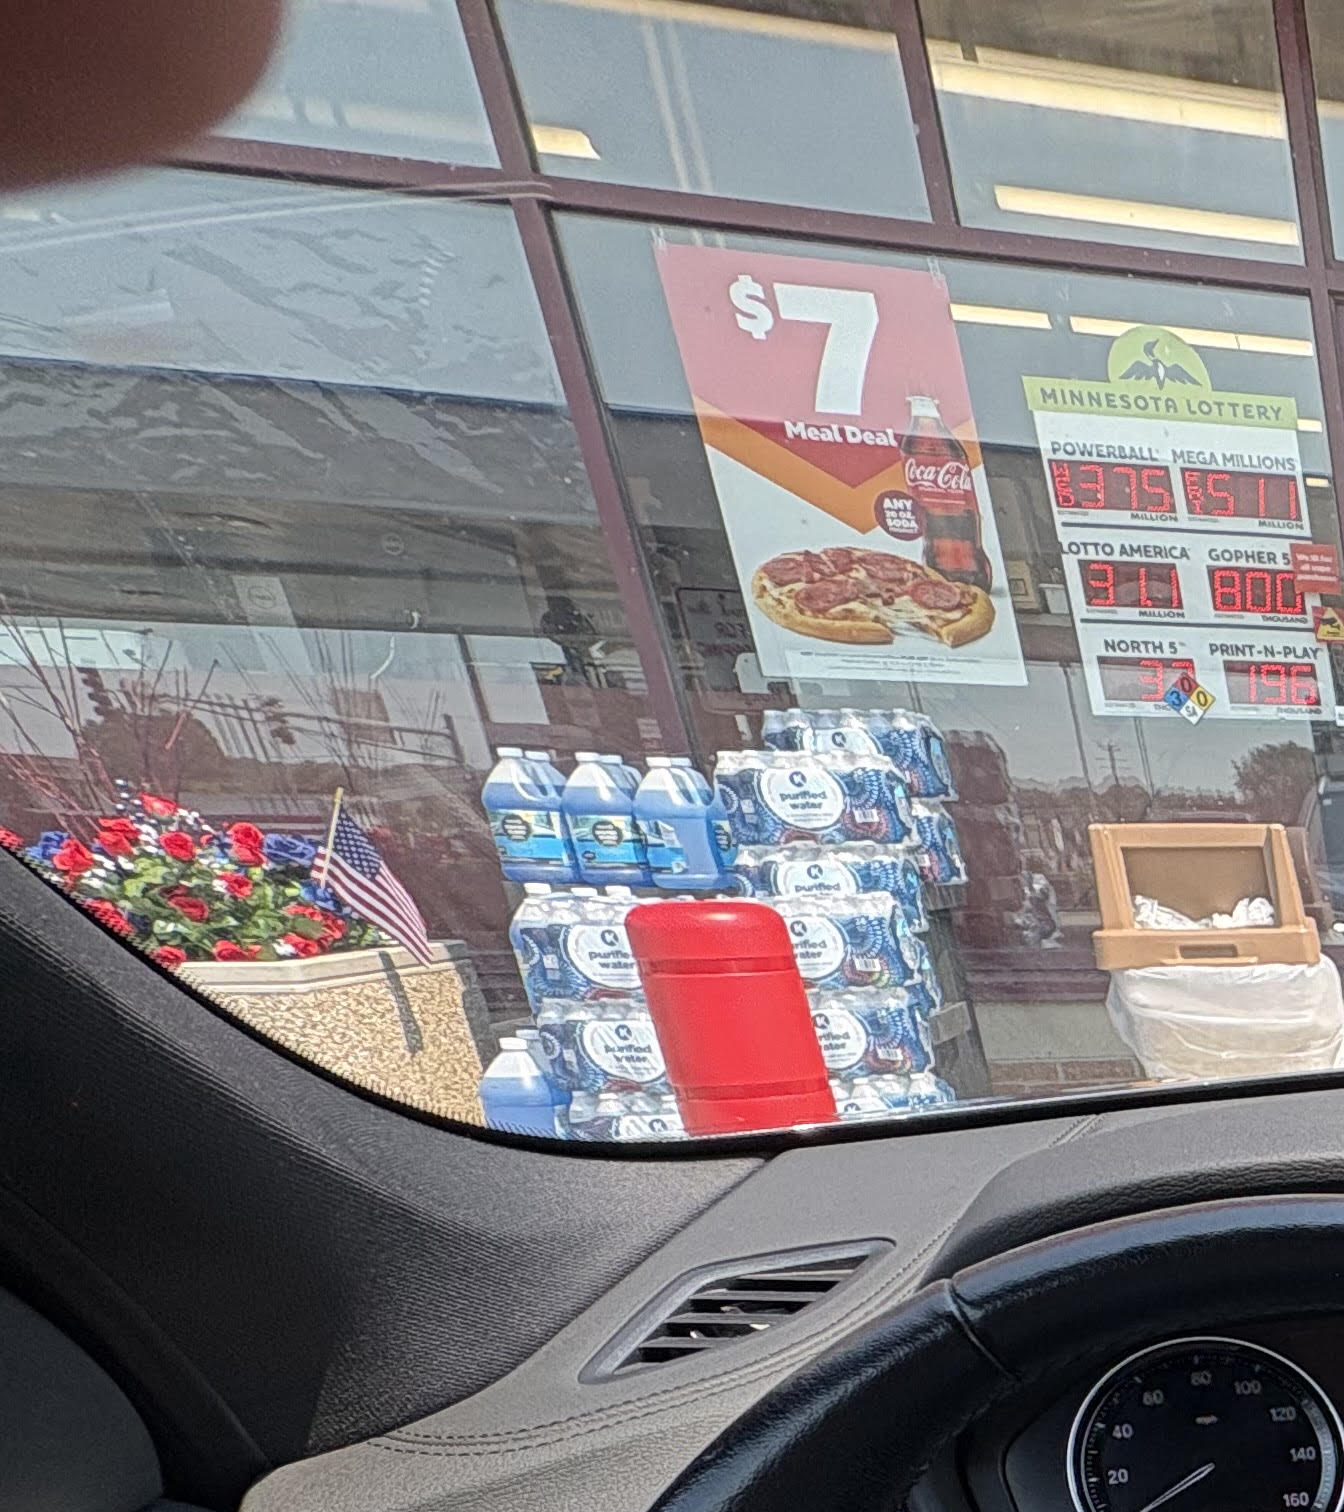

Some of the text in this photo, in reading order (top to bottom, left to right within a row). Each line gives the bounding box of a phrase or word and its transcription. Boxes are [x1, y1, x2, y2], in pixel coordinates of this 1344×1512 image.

[728, 274, 880, 416] $7
[1040, 387, 1282, 422] MINNESOTA LOTTERY
[783, 420, 898, 448] Meal Deal
[1050, 441, 1295, 471] POWERBALL MEGA MILLIONS
[905, 458, 972, 491] Coca-Cola
[1079, 463, 1171, 512] 375
[883, 497, 912, 510] ANY
[887, 518, 918, 529] SODA
[1130, 512, 1178, 522] MILLION
[1258, 519, 1304, 531] MILLION
[1061, 542, 1290, 565] LOTTO AMERICA GOPHER 5
[1213, 569, 1304, 614] 800
[1138, 610, 1185, 619] MILLION
[1104, 639, 1318, 660] NORTH 5 PRINT-N-PLAY
[1170, 690, 1208, 707] 3 0
[779, 791, 827, 801] purified
[789, 801, 822, 810] water
[795, 882, 841, 893] purified
[1191, 1371, 1212, 1385] 80
[1234, 1380, 1261, 1395] 100
[1142, 1390, 1164, 1405] 60
[1269, 1407, 1297, 1421] 120
[1112, 1424, 1133, 1439] 40
[1289, 1446, 1316, 1461] 140
[1108, 1468, 1129, 1484] 20
[1283, 1493, 1310, 1507] 160
